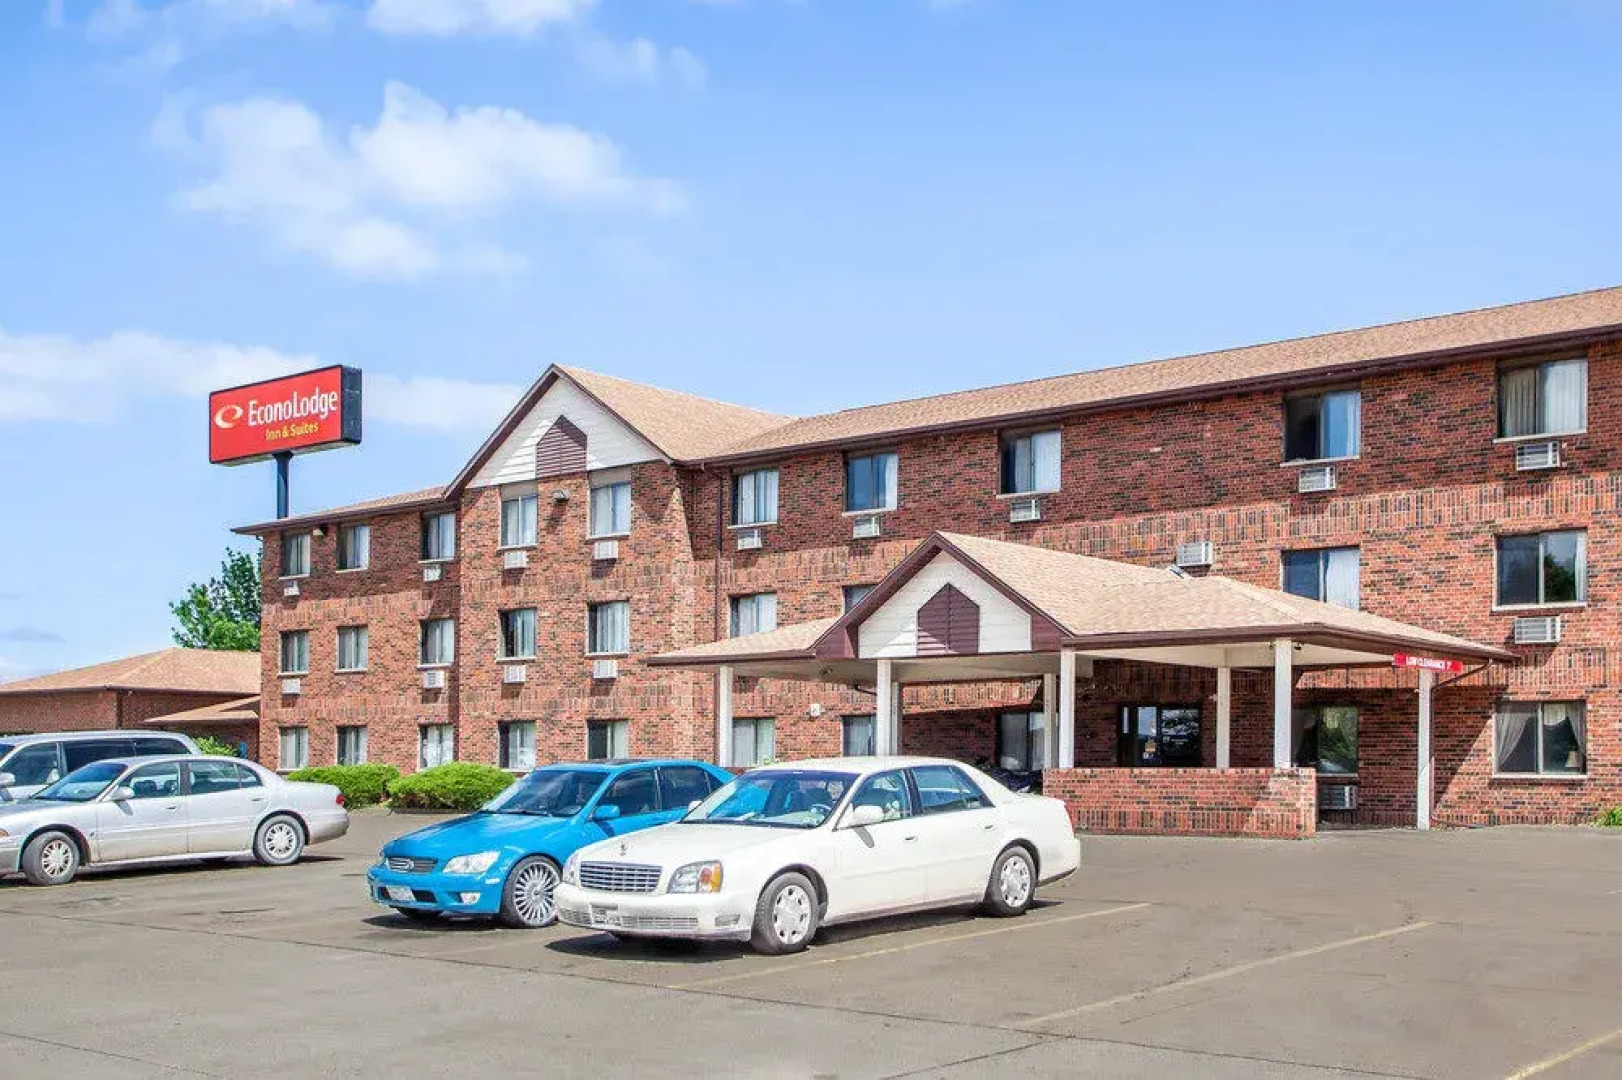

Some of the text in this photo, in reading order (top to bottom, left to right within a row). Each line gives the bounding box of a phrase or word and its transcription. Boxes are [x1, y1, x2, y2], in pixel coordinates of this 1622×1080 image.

[249, 386, 338, 426] EconoLodge
[266, 422, 318, 441] Inn & Suites
